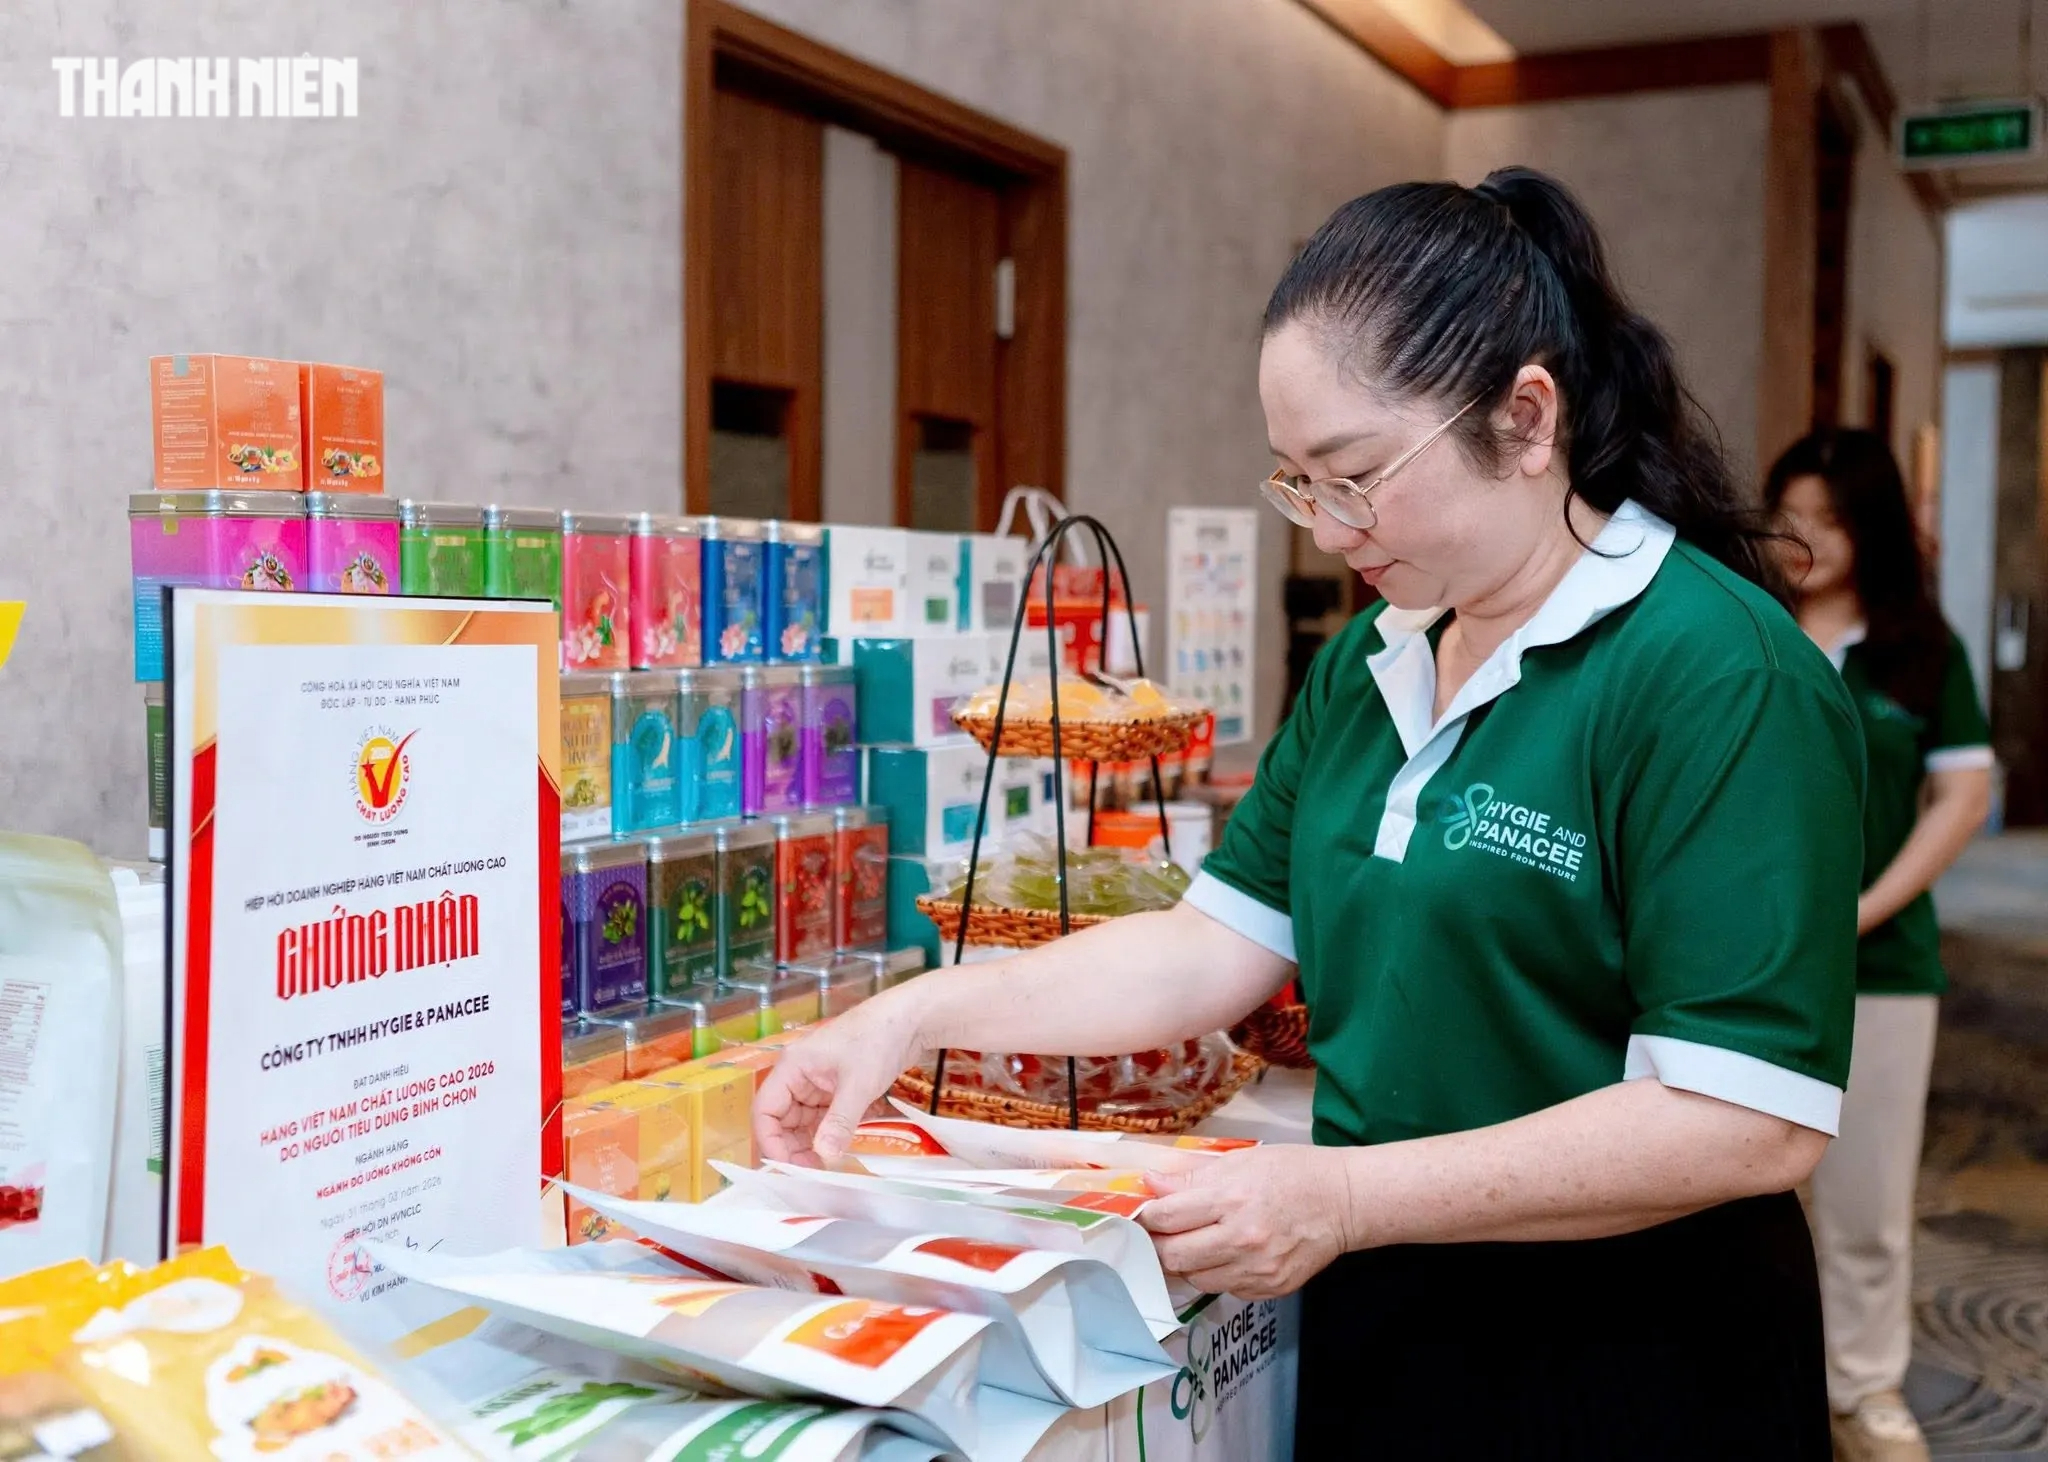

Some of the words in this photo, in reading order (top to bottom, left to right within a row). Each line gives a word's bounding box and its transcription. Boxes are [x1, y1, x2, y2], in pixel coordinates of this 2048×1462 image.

[441, 677, 460, 689] NAM
[1474, 820, 1583, 871] PANACEE
[1484, 801, 1551, 834] HYGIE
[1552, 826, 1587, 848] AND
[286, 885, 321, 904] DOANH
[406, 867, 426, 883] NAM
[486, 856, 507, 870] CAO
[1469, 840, 1508, 857] INSPIRED
[1510, 852, 1536, 867] FROM
[1538, 862, 1577, 882] NATURE
[276, 905, 388, 1001] CHỨNG
[394, 889, 479, 973] NHẬN
[261, 1044, 303, 1072] CÔNG
[306, 1036, 325, 1059] TY
[328, 1025, 367, 1052] TNHH
[369, 1013, 413, 1041] HYGIE
[415, 1011, 425, 1028] &
[427, 994, 490, 1026] PANACEE
[329, 1101, 357, 1124] NAM
[439, 1069, 464, 1088] CAO
[468, 1060, 495, 1081] 2026
[368, 1070, 391, 1085] DANH
[280, 1143, 299, 1163] DO
[1211, 1302, 1254, 1362] HYGIE
[1258, 1299, 1277, 1318] AND
[1213, 1317, 1277, 1399] PANACEE
